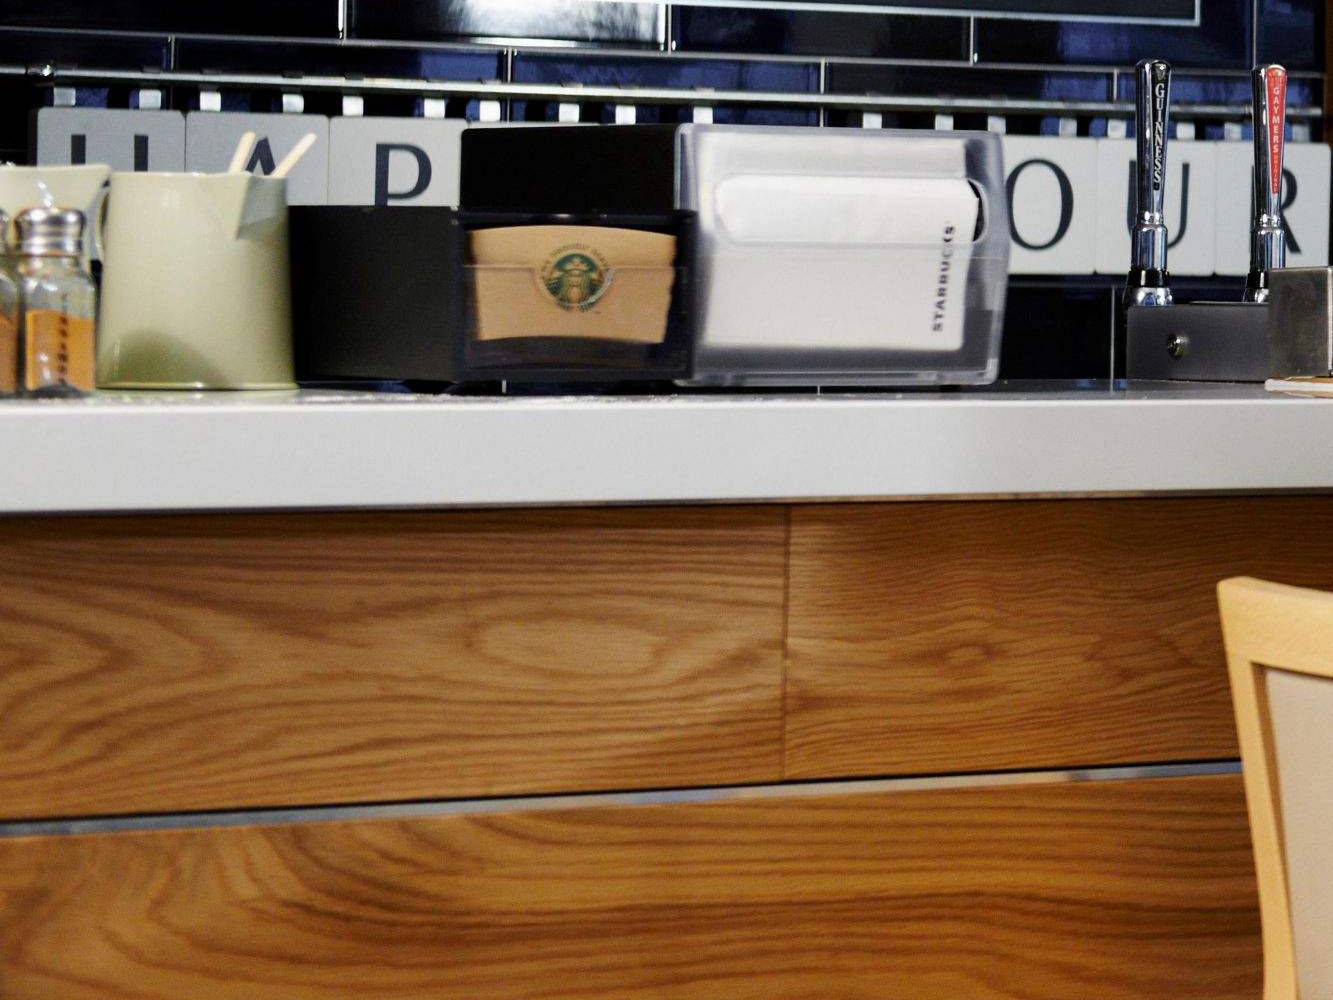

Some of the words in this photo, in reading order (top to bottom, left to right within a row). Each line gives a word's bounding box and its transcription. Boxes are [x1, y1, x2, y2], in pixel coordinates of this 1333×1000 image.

[1153, 83, 1165, 183] GUINNESS
[1271, 87, 1280, 153] GAYMERS
[1005, 158, 1302, 254] OUR
